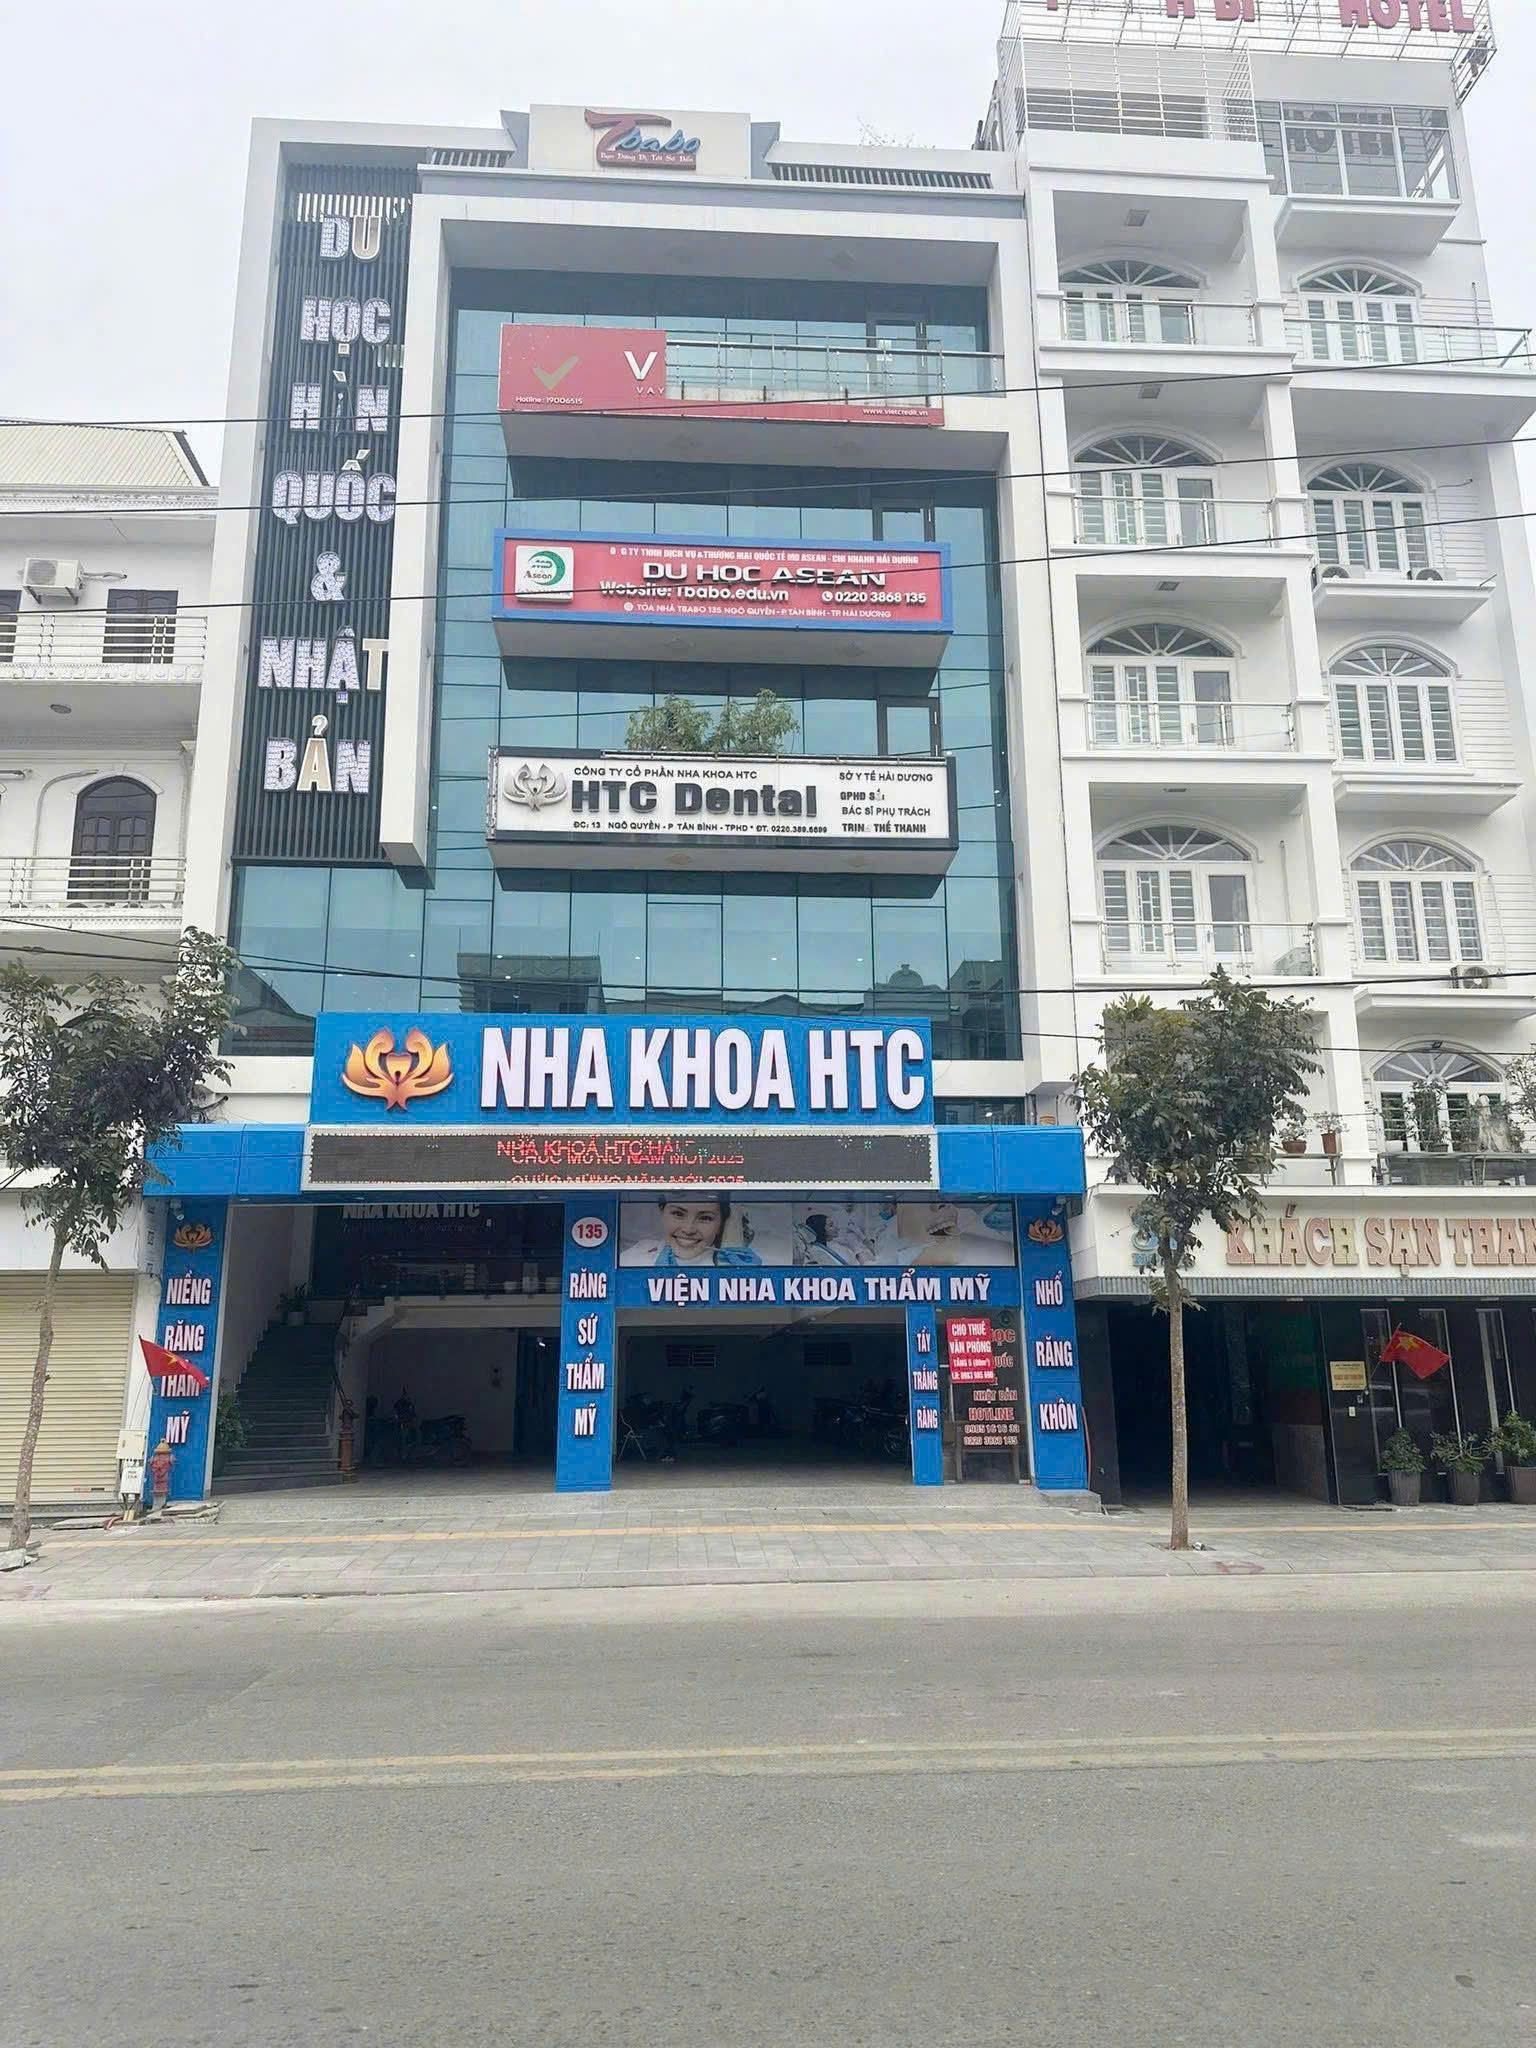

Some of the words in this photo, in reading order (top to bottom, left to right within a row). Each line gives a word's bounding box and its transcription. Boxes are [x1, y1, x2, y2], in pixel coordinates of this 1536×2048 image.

[300, 298, 392, 355] HỌC
[271, 448, 396, 525] QUỐC
[310, 551, 348, 600] &
[642, 561, 689, 580] DU
[771, 566, 886, 588] ASEAN
[835, 591, 867, 603] 0220
[869, 591, 901, 603] 3868
[904, 592, 926, 604] 135
[257, 625, 389, 704] NHẬT
[263, 714, 372, 793] BẢN
[574, 765, 606, 776] CÔNG
[609, 767, 622, 777] TY
[625, 764, 641, 777] CỔ
[677, 769, 700, 779] NHA
[702, 769, 733, 779] KHOA
[736, 771, 757, 780] HTC
[855, 772, 862, 780] Y
[571, 779, 658, 814] HTC
[674, 782, 818, 818] Dental
[842, 804, 862, 815] BÁC
[876, 807, 896, 817] PHỤ
[725, 824, 748, 832] TPHD
[873, 820, 892, 833] THẾ
[481, 1025, 614, 1109] NHA
[628, 1027, 795, 1110] KHOA
[809, 1028, 926, 1111] HTC
[577, 1223, 604, 1239] 135
[1226, 1203, 1359, 1267] KHÁCH
[1365, 1217, 1442, 1277] SẠN
[166, 1268, 212, 1305] NIỀNG
[569, 1267, 607, 1299] RĂNG
[647, 1273, 709, 1306] VIỆN
[718, 1277, 776, 1301] NHA
[783, 1277, 857, 1302] KHOA
[863, 1267, 941, 1302] THẨM
[949, 1272, 991, 1301] MỸ
[1035, 1270, 1064, 1306] NHỔ
[164, 1320, 205, 1352] RĂNG
[577, 1312, 599, 1345] SỨ
[951, 1323, 967, 1336] CHO
[965, 1337, 992, 1353] PHÒNG
[1035, 1336, 1073, 1367] RĂNG
[566, 1352, 605, 1390] THẨM
[973, 1388, 997, 1404] NHẬT
[166, 1411, 191, 1444] MỸ
[574, 1403, 597, 1436] MỸ
[968, 1407, 1015, 1421] HOTLINE
[1039, 1398, 1078, 1430] KHÔN
